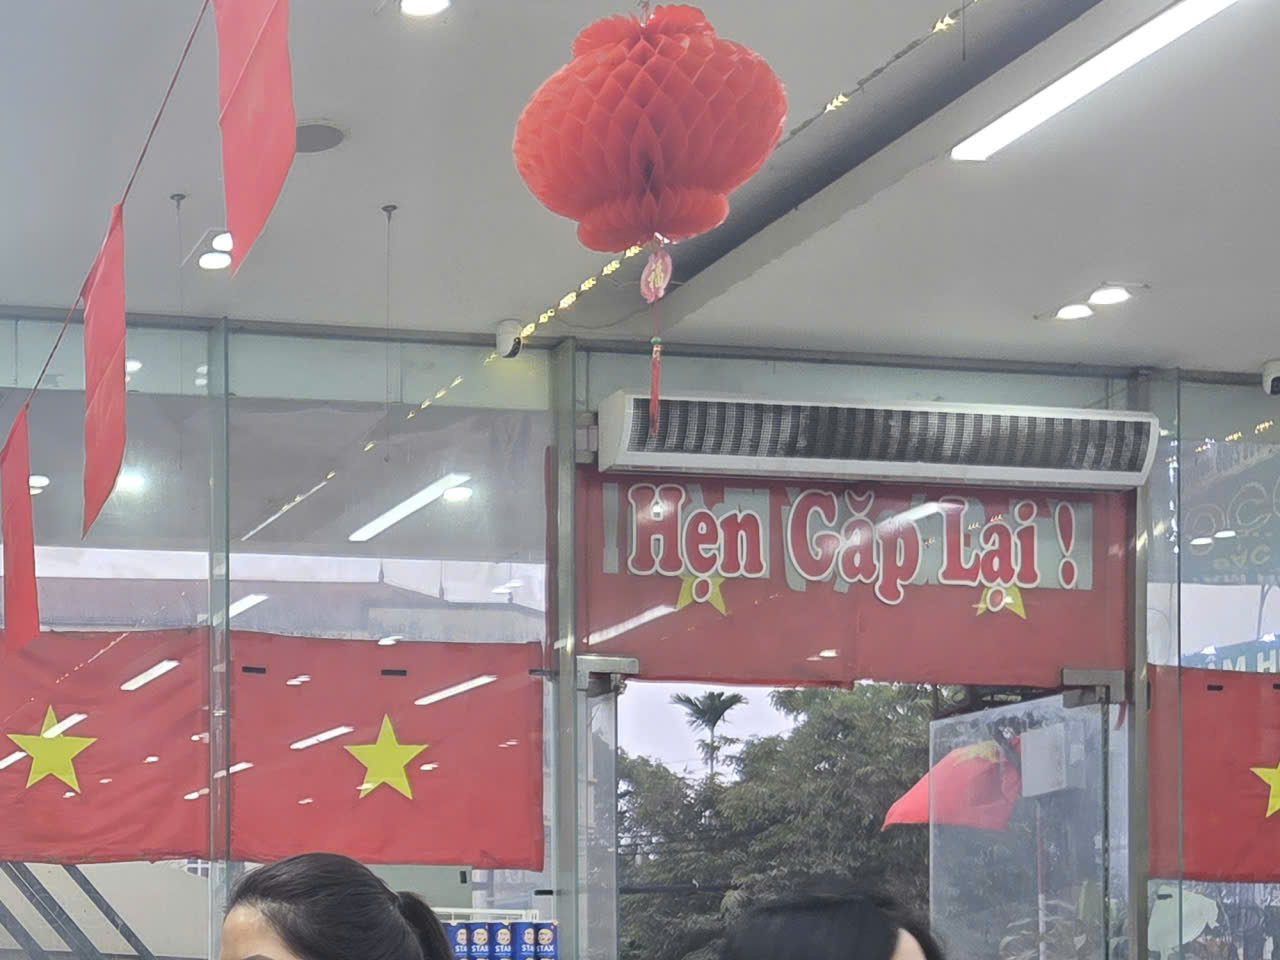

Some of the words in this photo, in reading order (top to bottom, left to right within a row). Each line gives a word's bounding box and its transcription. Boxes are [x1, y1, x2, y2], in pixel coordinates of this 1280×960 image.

[628, 483, 767, 603] Hẹn
[939, 496, 1040, 611] Lại
[1055, 502, 1078, 589] !
